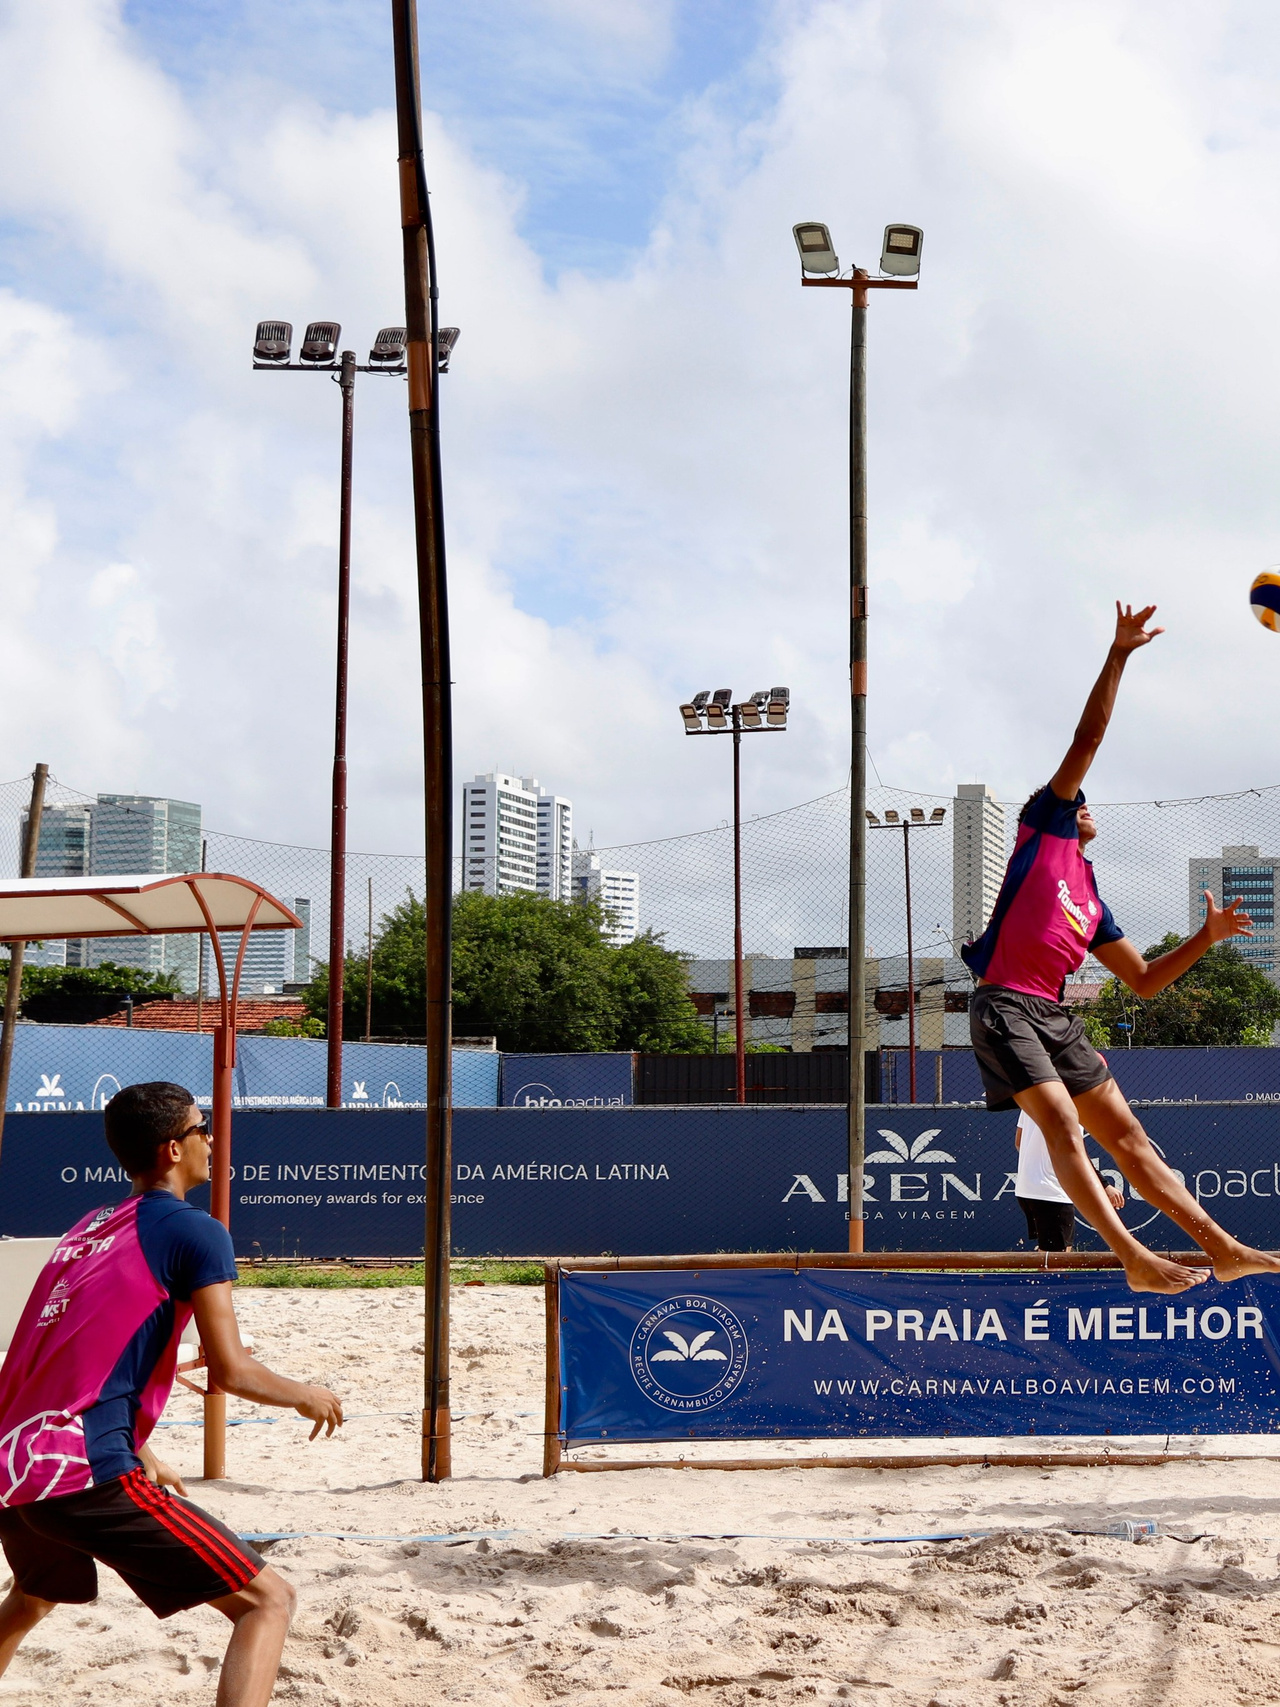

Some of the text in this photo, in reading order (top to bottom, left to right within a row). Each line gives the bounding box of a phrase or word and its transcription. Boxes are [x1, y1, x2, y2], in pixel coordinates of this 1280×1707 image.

[61, 1167, 77, 1183] O
[243, 1161, 670, 1181] DE INVESTIMENTO DA AMÉRICA LATINA
[240, 1195, 321, 1207] euromoney
[326, 1192, 377, 1205] awards
[382, 1192, 403, 1204] for
[898, 1210, 976, 1220] VIAGEM
[638, 1300, 742, 1340] CARNAVAL BOA VIAGEM
[783, 1299, 1264, 1342] NA PRAIA É MELHOR
[634, 1354, 744, 1408] RECIFE PERNAMBUCO BRASIL
[813, 1378, 1236, 1395] WWW.CARNAVALBOAVIAGEM.COM
